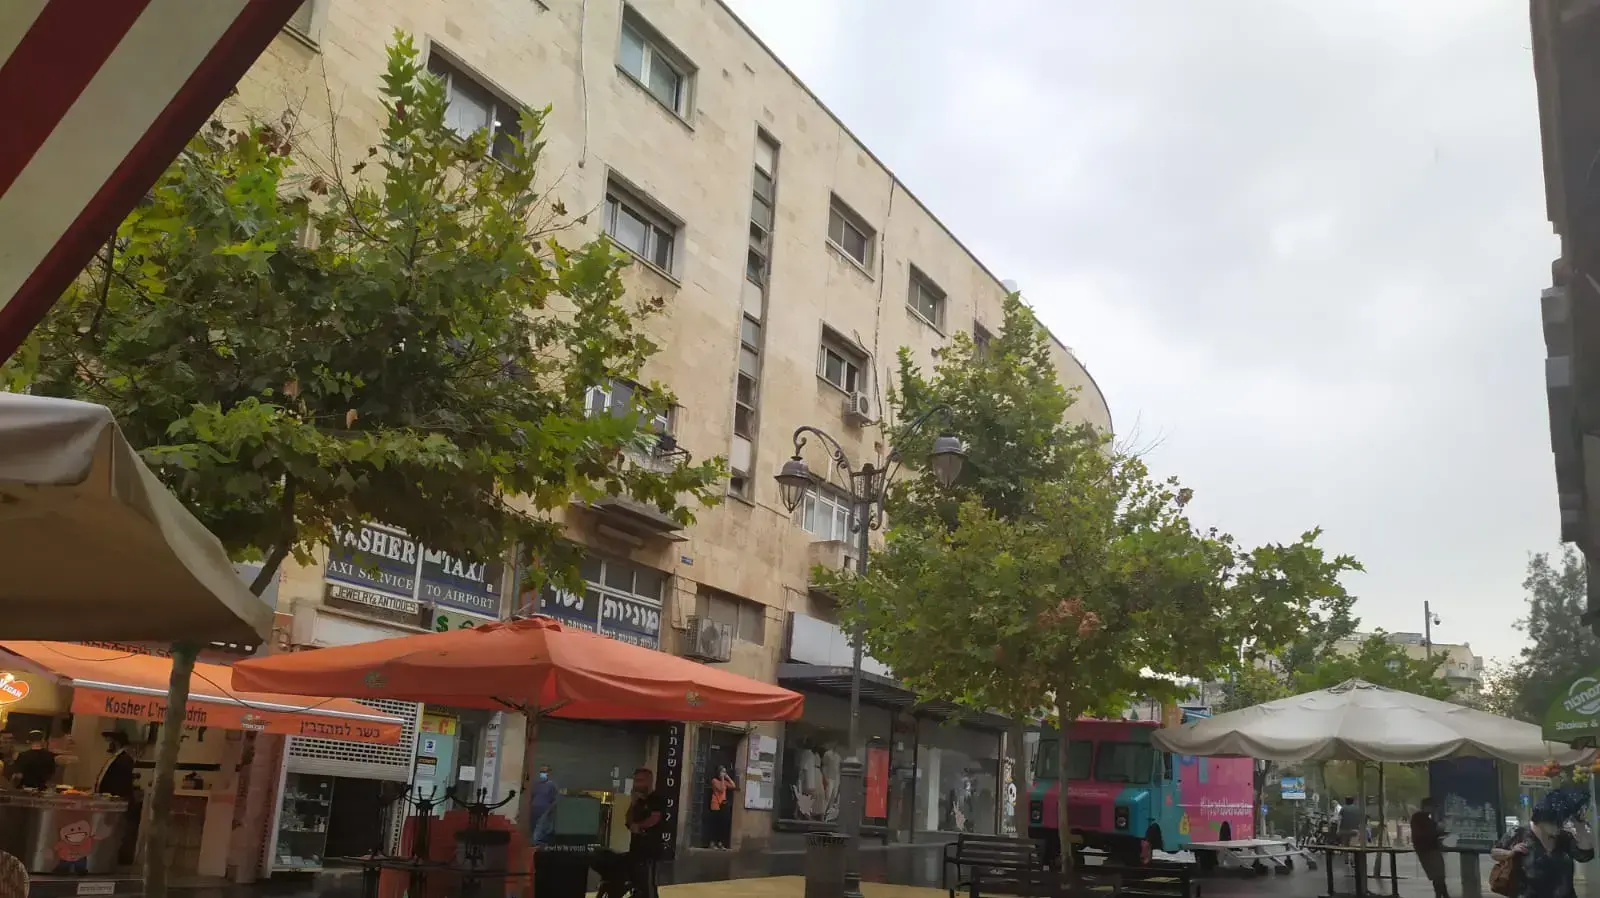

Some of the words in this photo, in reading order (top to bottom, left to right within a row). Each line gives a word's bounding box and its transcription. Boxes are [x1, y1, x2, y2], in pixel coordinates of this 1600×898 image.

[328, 560, 353, 576] AXI
[426, 584, 441, 597] TO
[443, 588, 494, 609] AIRPORT
[604, 598, 659, 632] מוניות
[105, 696, 145, 717] Kosher
[299, 719, 352, 738] למהדרין
[355, 727, 381, 739] כשר
[1590, 719, 1598, 728] &
